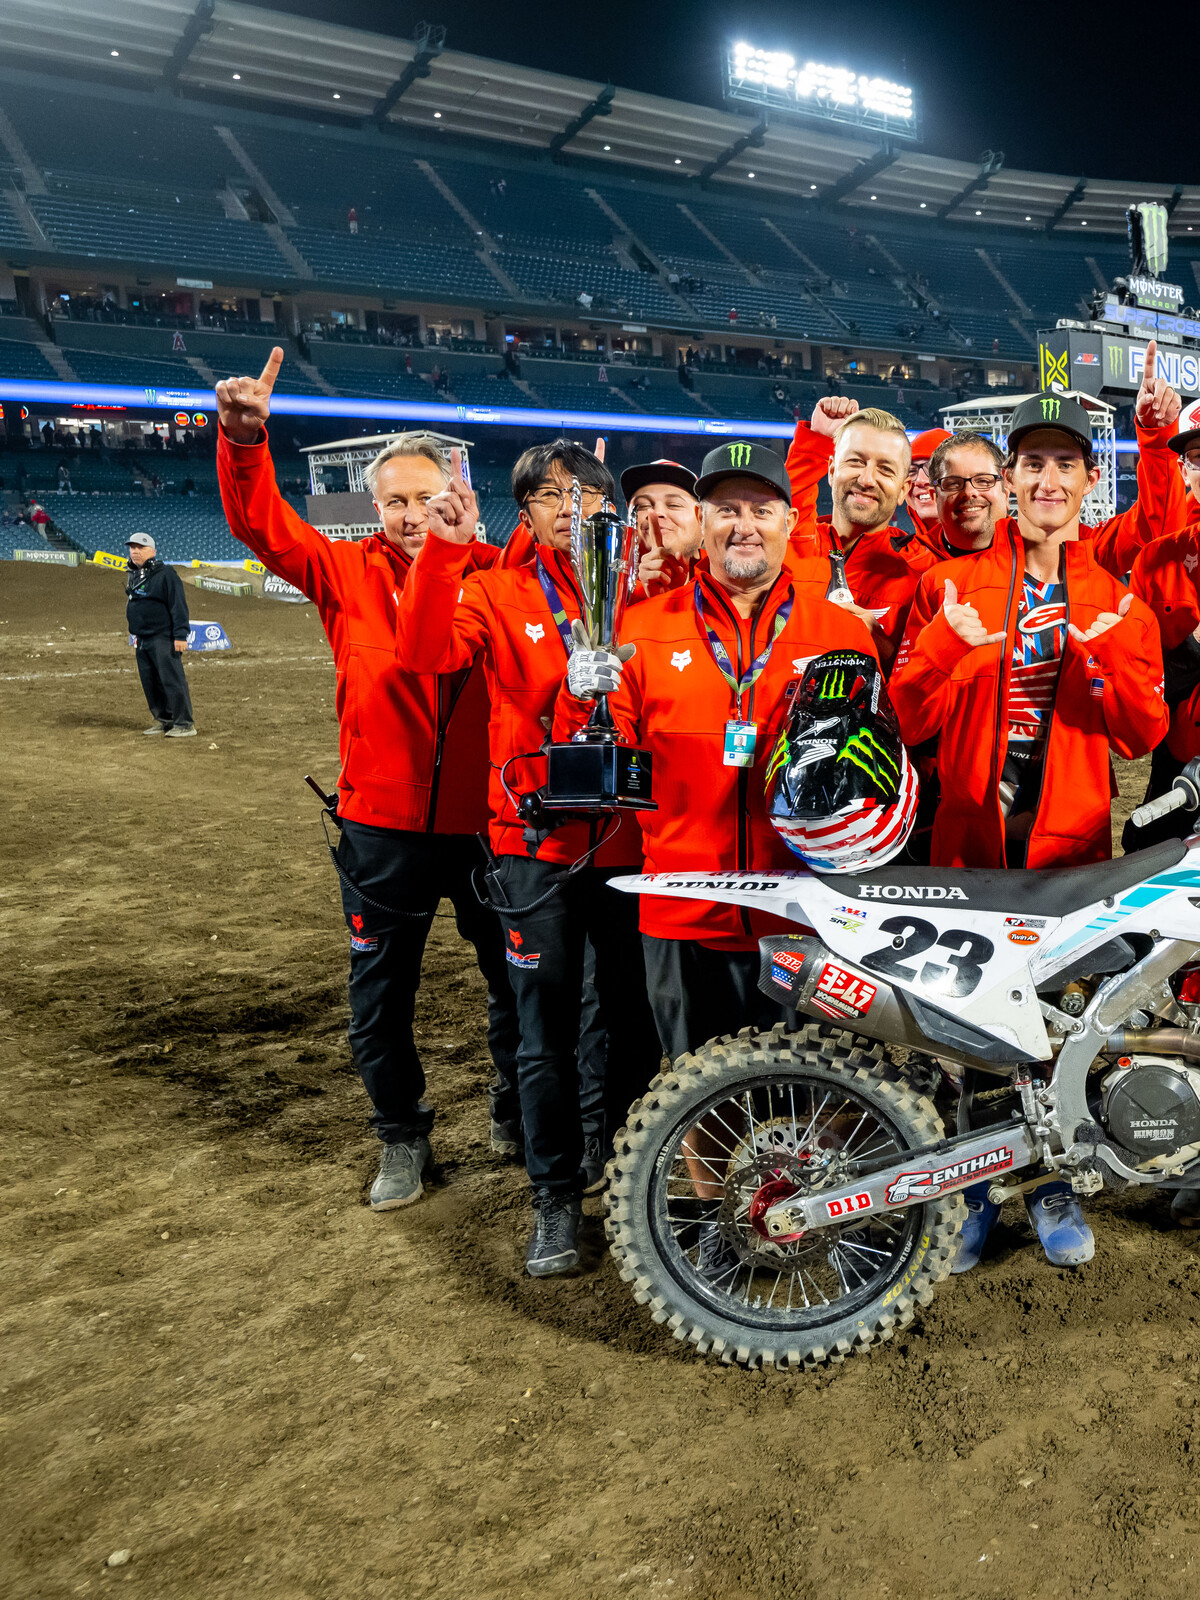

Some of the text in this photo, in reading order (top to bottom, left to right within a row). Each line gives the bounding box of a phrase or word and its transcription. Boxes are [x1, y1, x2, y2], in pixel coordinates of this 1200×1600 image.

[1129, 278, 1184, 301] MONSTER
[1138, 297, 1176, 310] ENERGY
[26, 552, 66, 561] MONSTER
[202, 581, 232, 593] MONSTER
[815, 659, 866, 669] MONSTER
[662, 881, 780, 891] DUNLOP
[857, 884, 969, 900] HONDA
[1011, 933, 1027, 941] Twin
[859, 915, 995, 998] 23
[818, 965, 876, 1009] ヨシムラ
[814, 990, 860, 1018] YOSHIMURA
[1130, 1119, 1178, 1128] HONDA
[888, 1149, 1012, 1204] RENTHAL
[883, 1235, 930, 1307] DUNLOP
